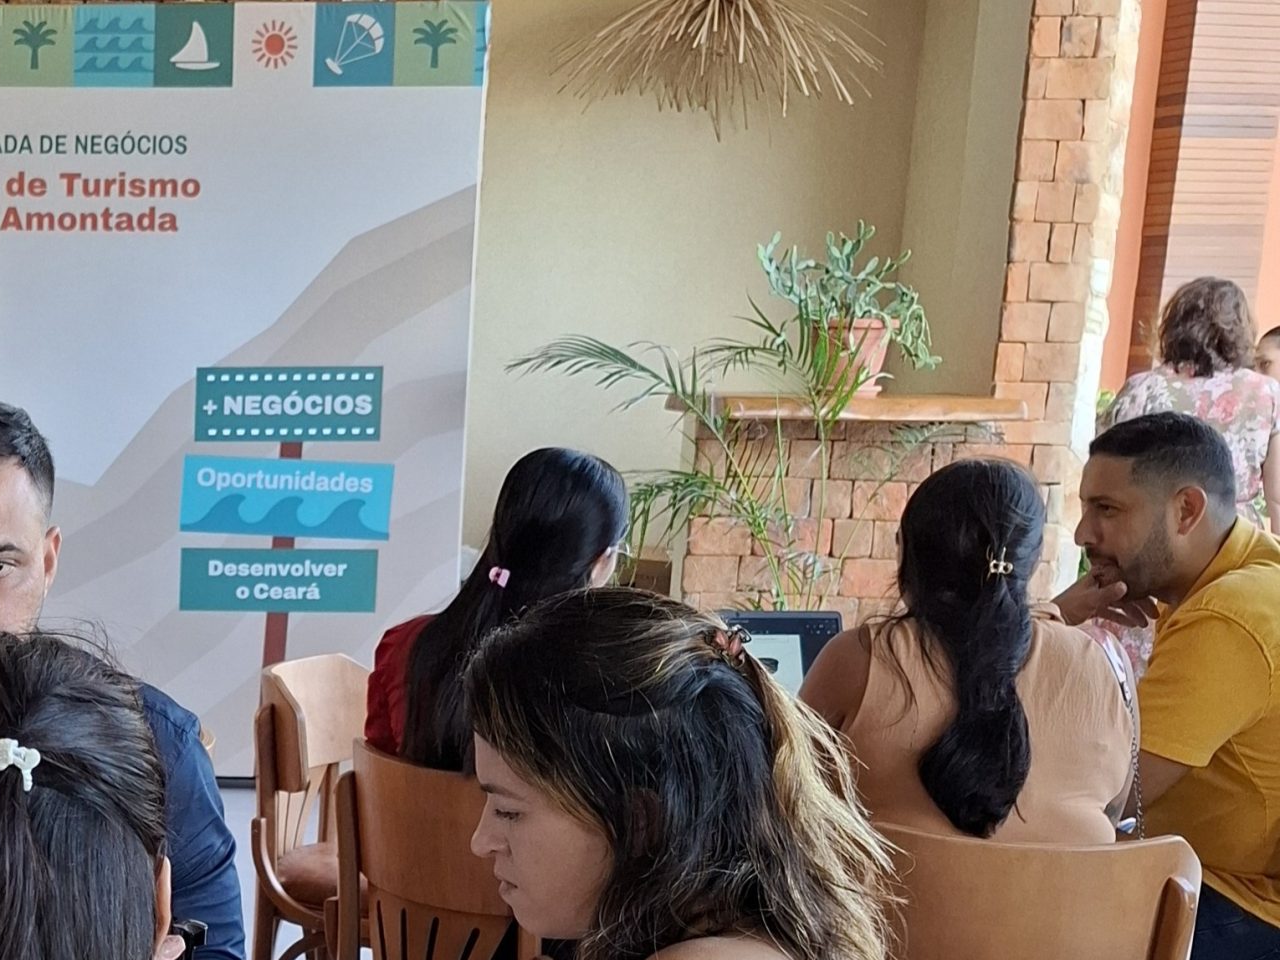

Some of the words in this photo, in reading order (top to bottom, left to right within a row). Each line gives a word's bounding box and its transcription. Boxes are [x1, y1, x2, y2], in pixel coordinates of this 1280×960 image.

[39, 134, 67, 155] DE
[74, 130, 187, 155] NEGÓCIOS
[5, 171, 47, 197] de
[59, 172, 201, 198] Turismo
[0, 206, 178, 232] Amontada
[223, 391, 373, 416] NEGÓCIOS
[197, 467, 373, 493] Oportunidades
[208, 559, 347, 577] Desenvolver
[236, 585, 249, 599] o
[254, 583, 320, 600] Ceará
